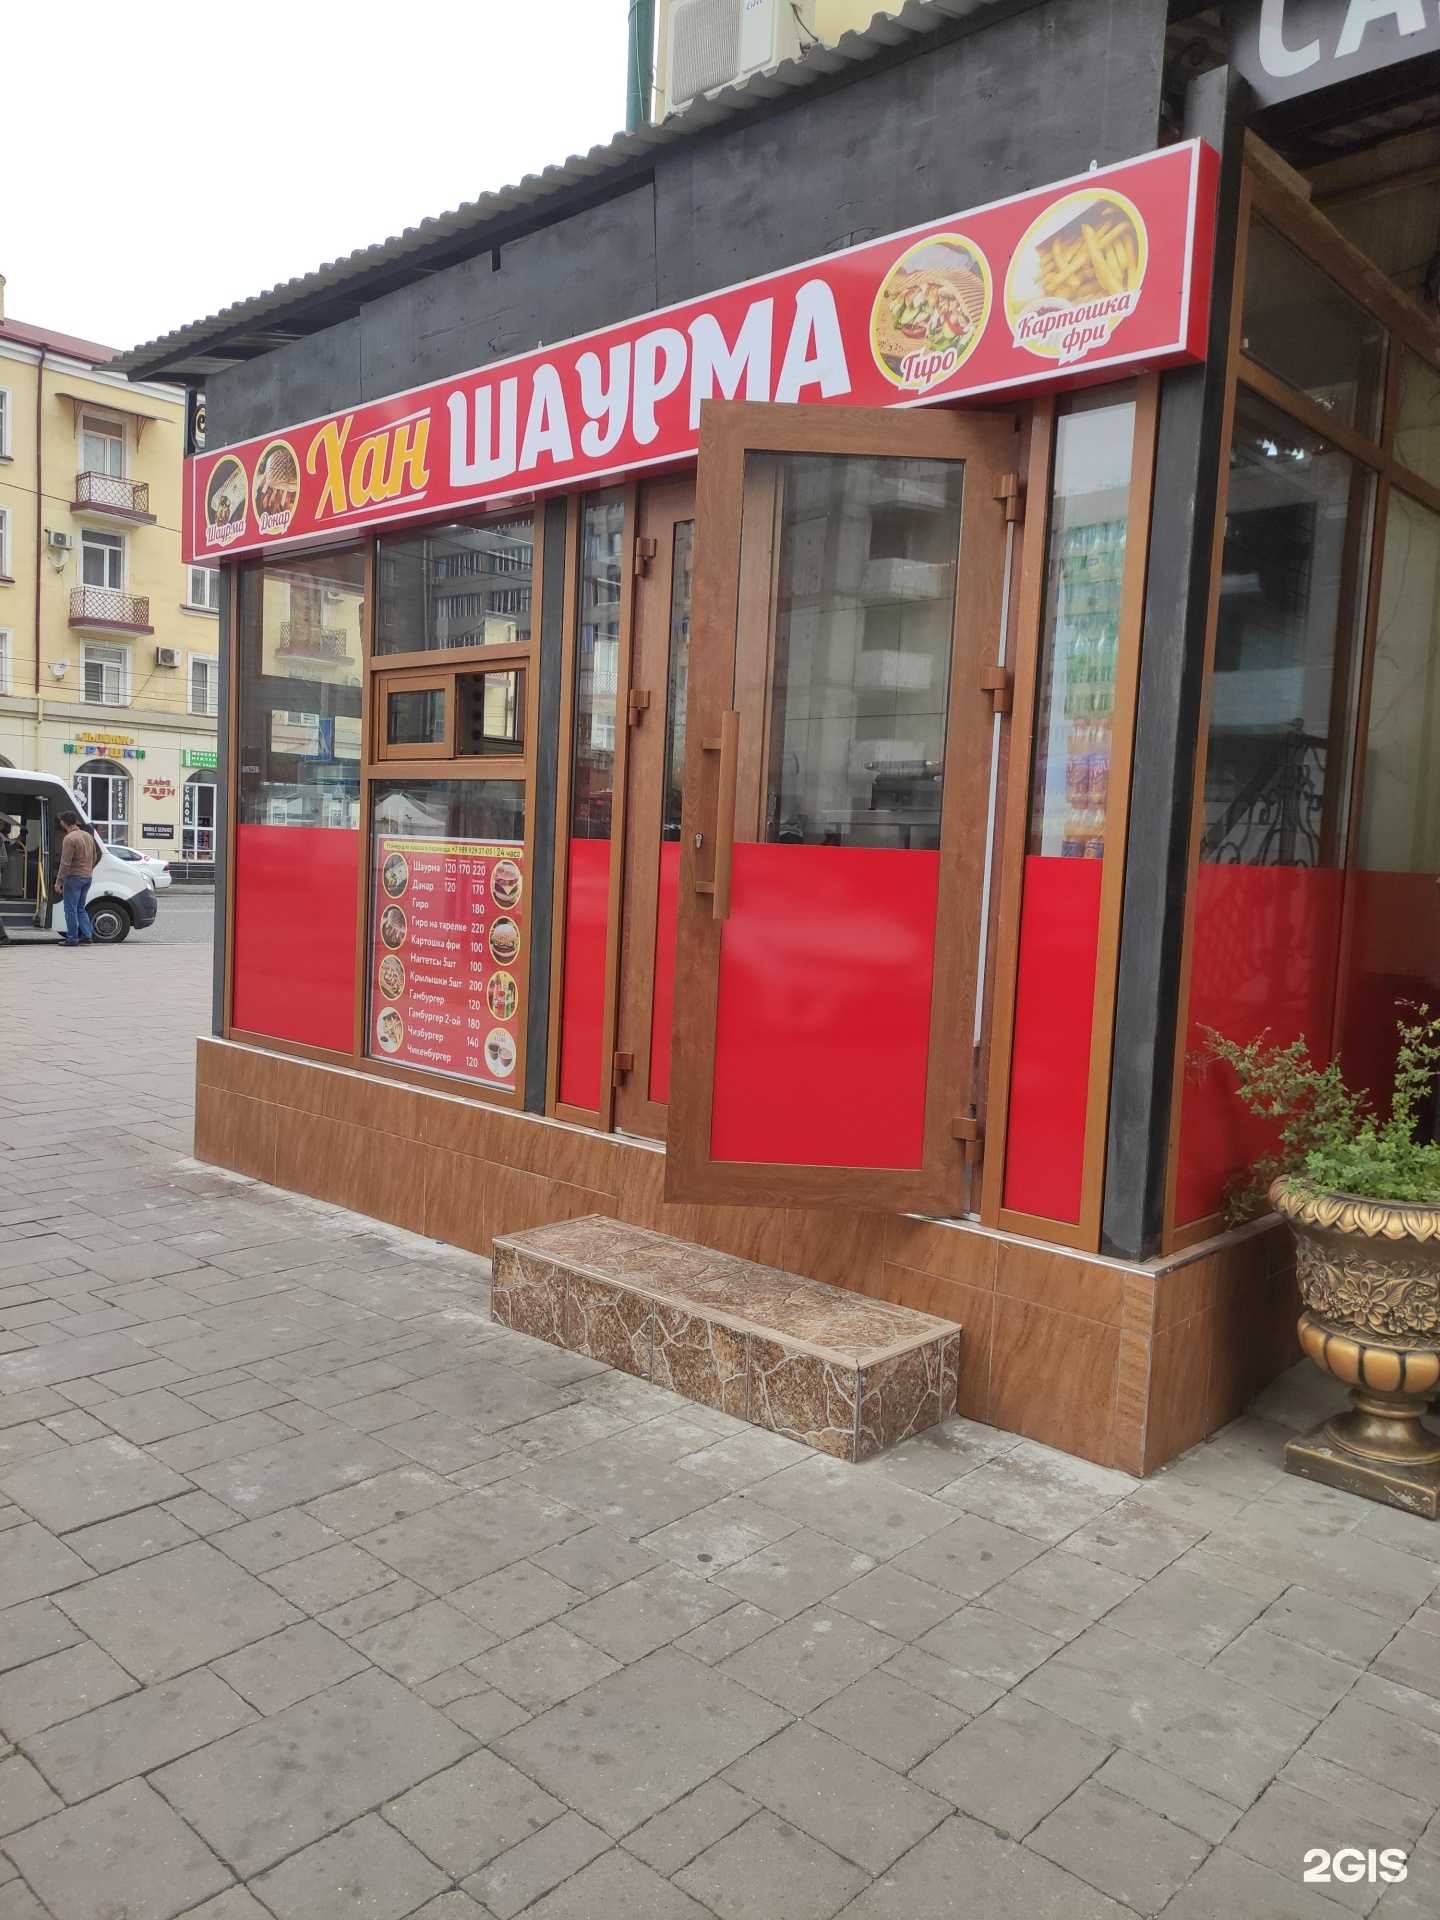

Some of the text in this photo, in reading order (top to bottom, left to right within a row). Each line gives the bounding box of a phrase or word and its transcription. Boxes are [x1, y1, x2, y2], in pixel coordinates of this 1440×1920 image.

[1259, 0, 1440, 77] СА
[1018, 293, 1132, 341] Картошка
[1062, 325, 1107, 354] фри
[902, 350, 955, 387] Гиро
[306, 279, 852, 520] Хан ШАУРМА
[206, 519, 245, 545] Шаурма
[260, 510, 291, 532] Донар
[413, 861, 486, 877] Шаурма 120 170 220
[444, 881, 456, 893] 120
[472, 884, 485, 895] 170
[412, 898, 485, 915] Гиро 180
[411, 916, 485, 934] Гиро на тарелке 220
[411, 936, 483, 953] Картошка фри 100
[443, 957, 457, 968] 5шт
[470, 961, 482, 973] 100
[410, 972, 482, 992] Крылышки 5шт 200
[409, 989, 481, 1011] Гамбургер 120
[408, 1007, 444, 1024] Гамбургер
[467, 1019, 480, 1030] 180
[407, 1026, 479, 1049] Чизбургер 140
[407, 1044, 478, 1068] Чикенбургер 120
